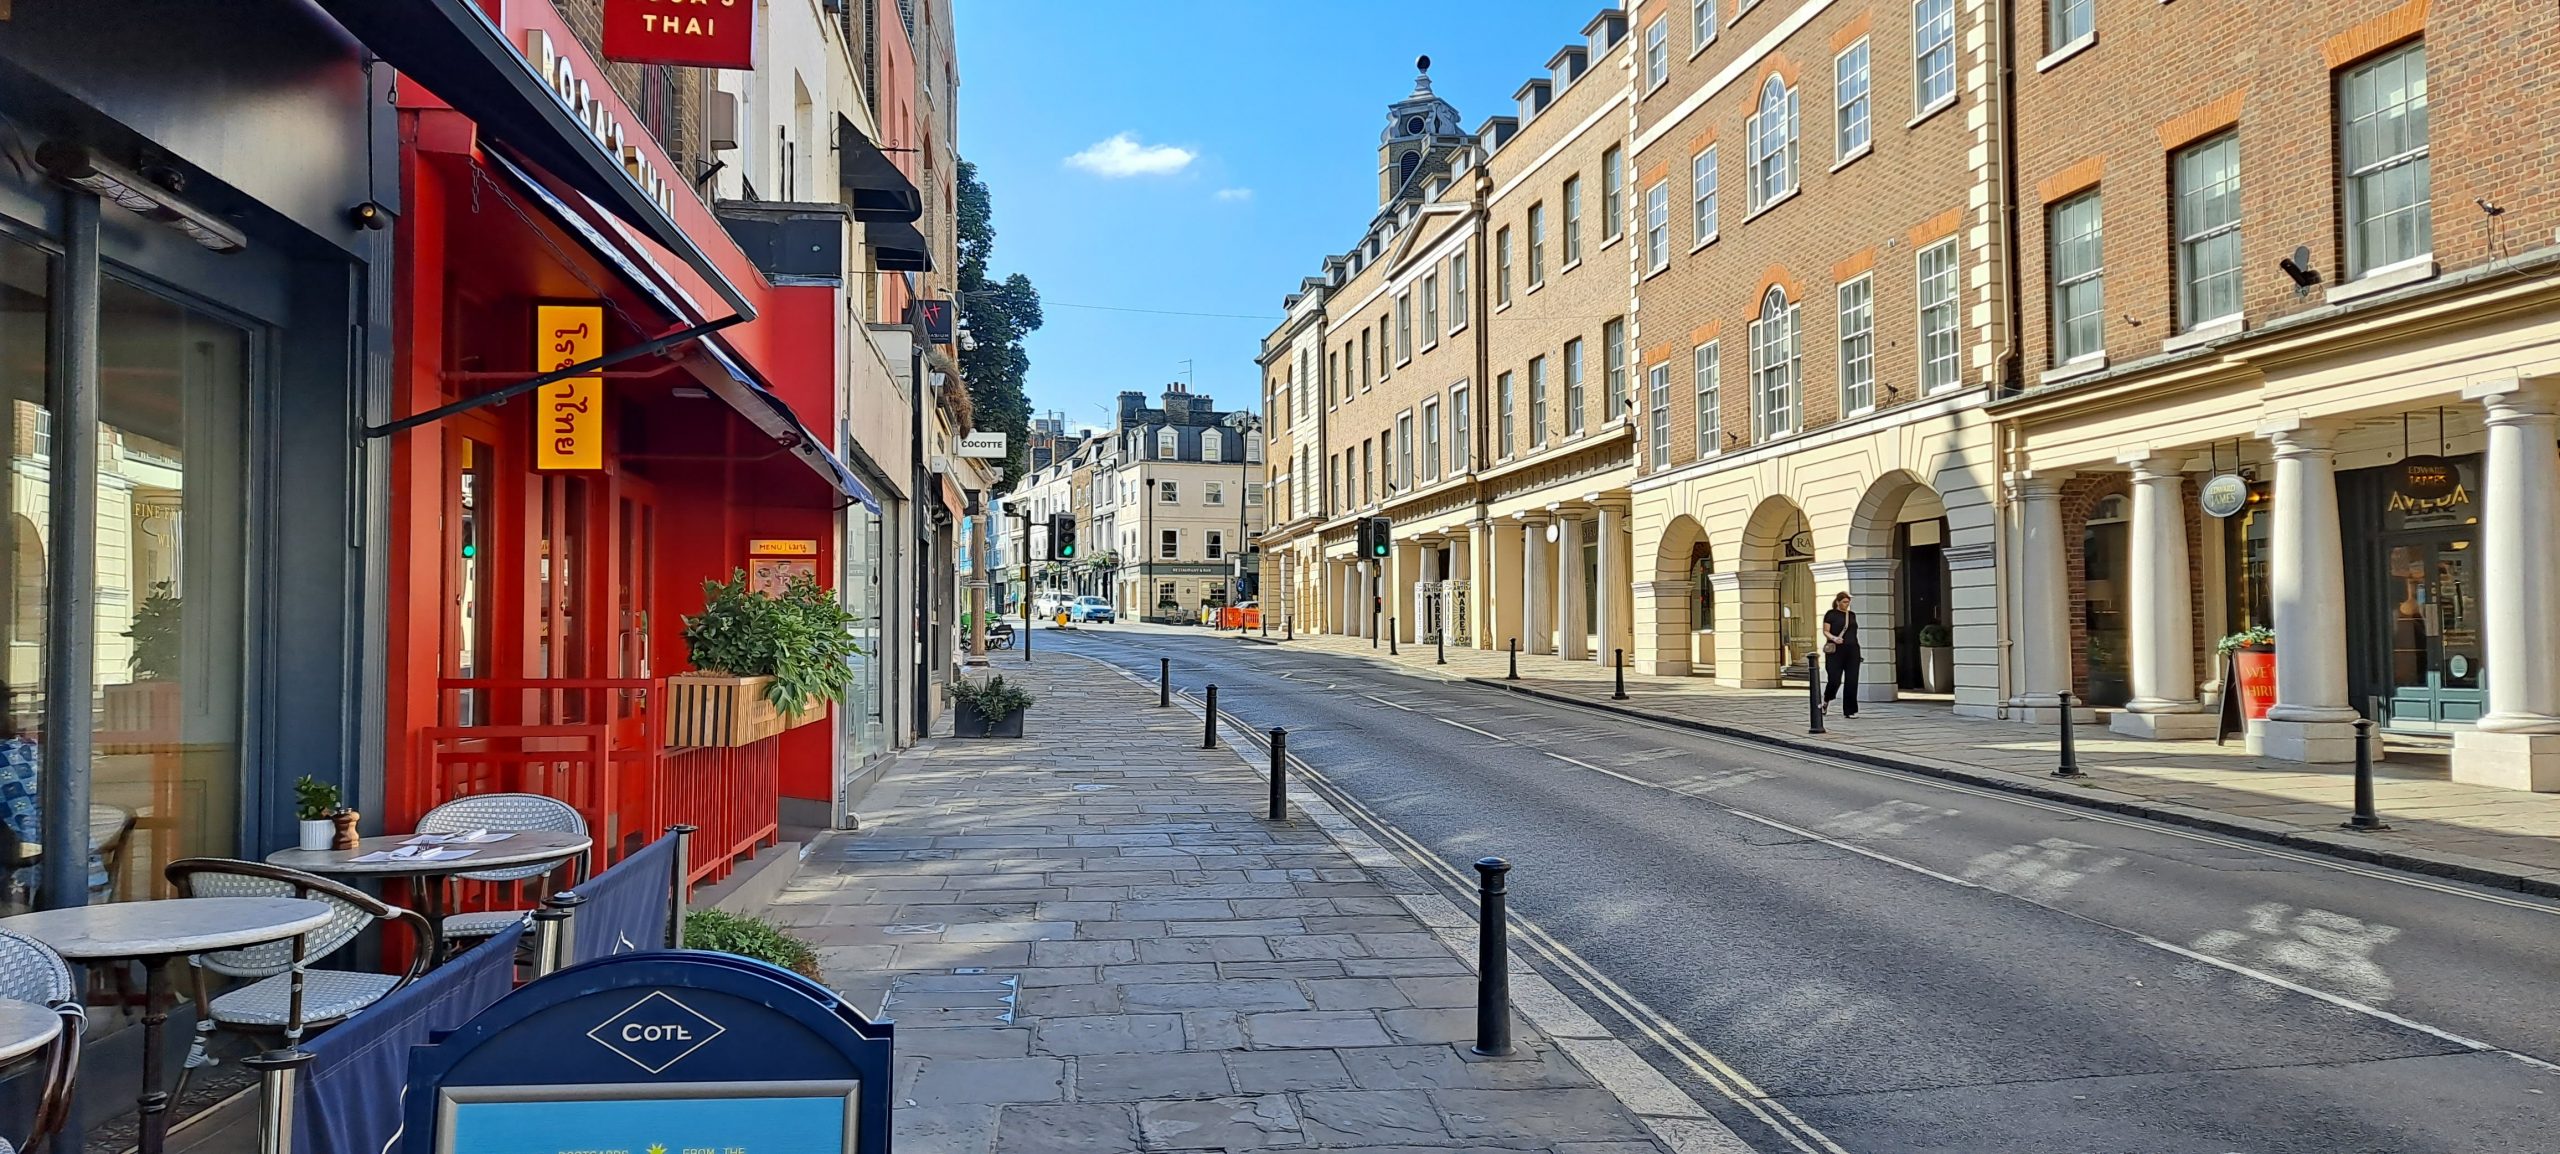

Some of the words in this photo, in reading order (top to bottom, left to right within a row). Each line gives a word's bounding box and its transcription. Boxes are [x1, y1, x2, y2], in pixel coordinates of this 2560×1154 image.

[642, 14, 714, 36] THAI
[961, 440, 1003, 449] COCOTTE
[2210, 492, 2236, 507] JAMES
[135, 503, 161, 519] FINE
[759, 543, 783, 551] MENU
[1457, 591, 1466, 636] MARKET
